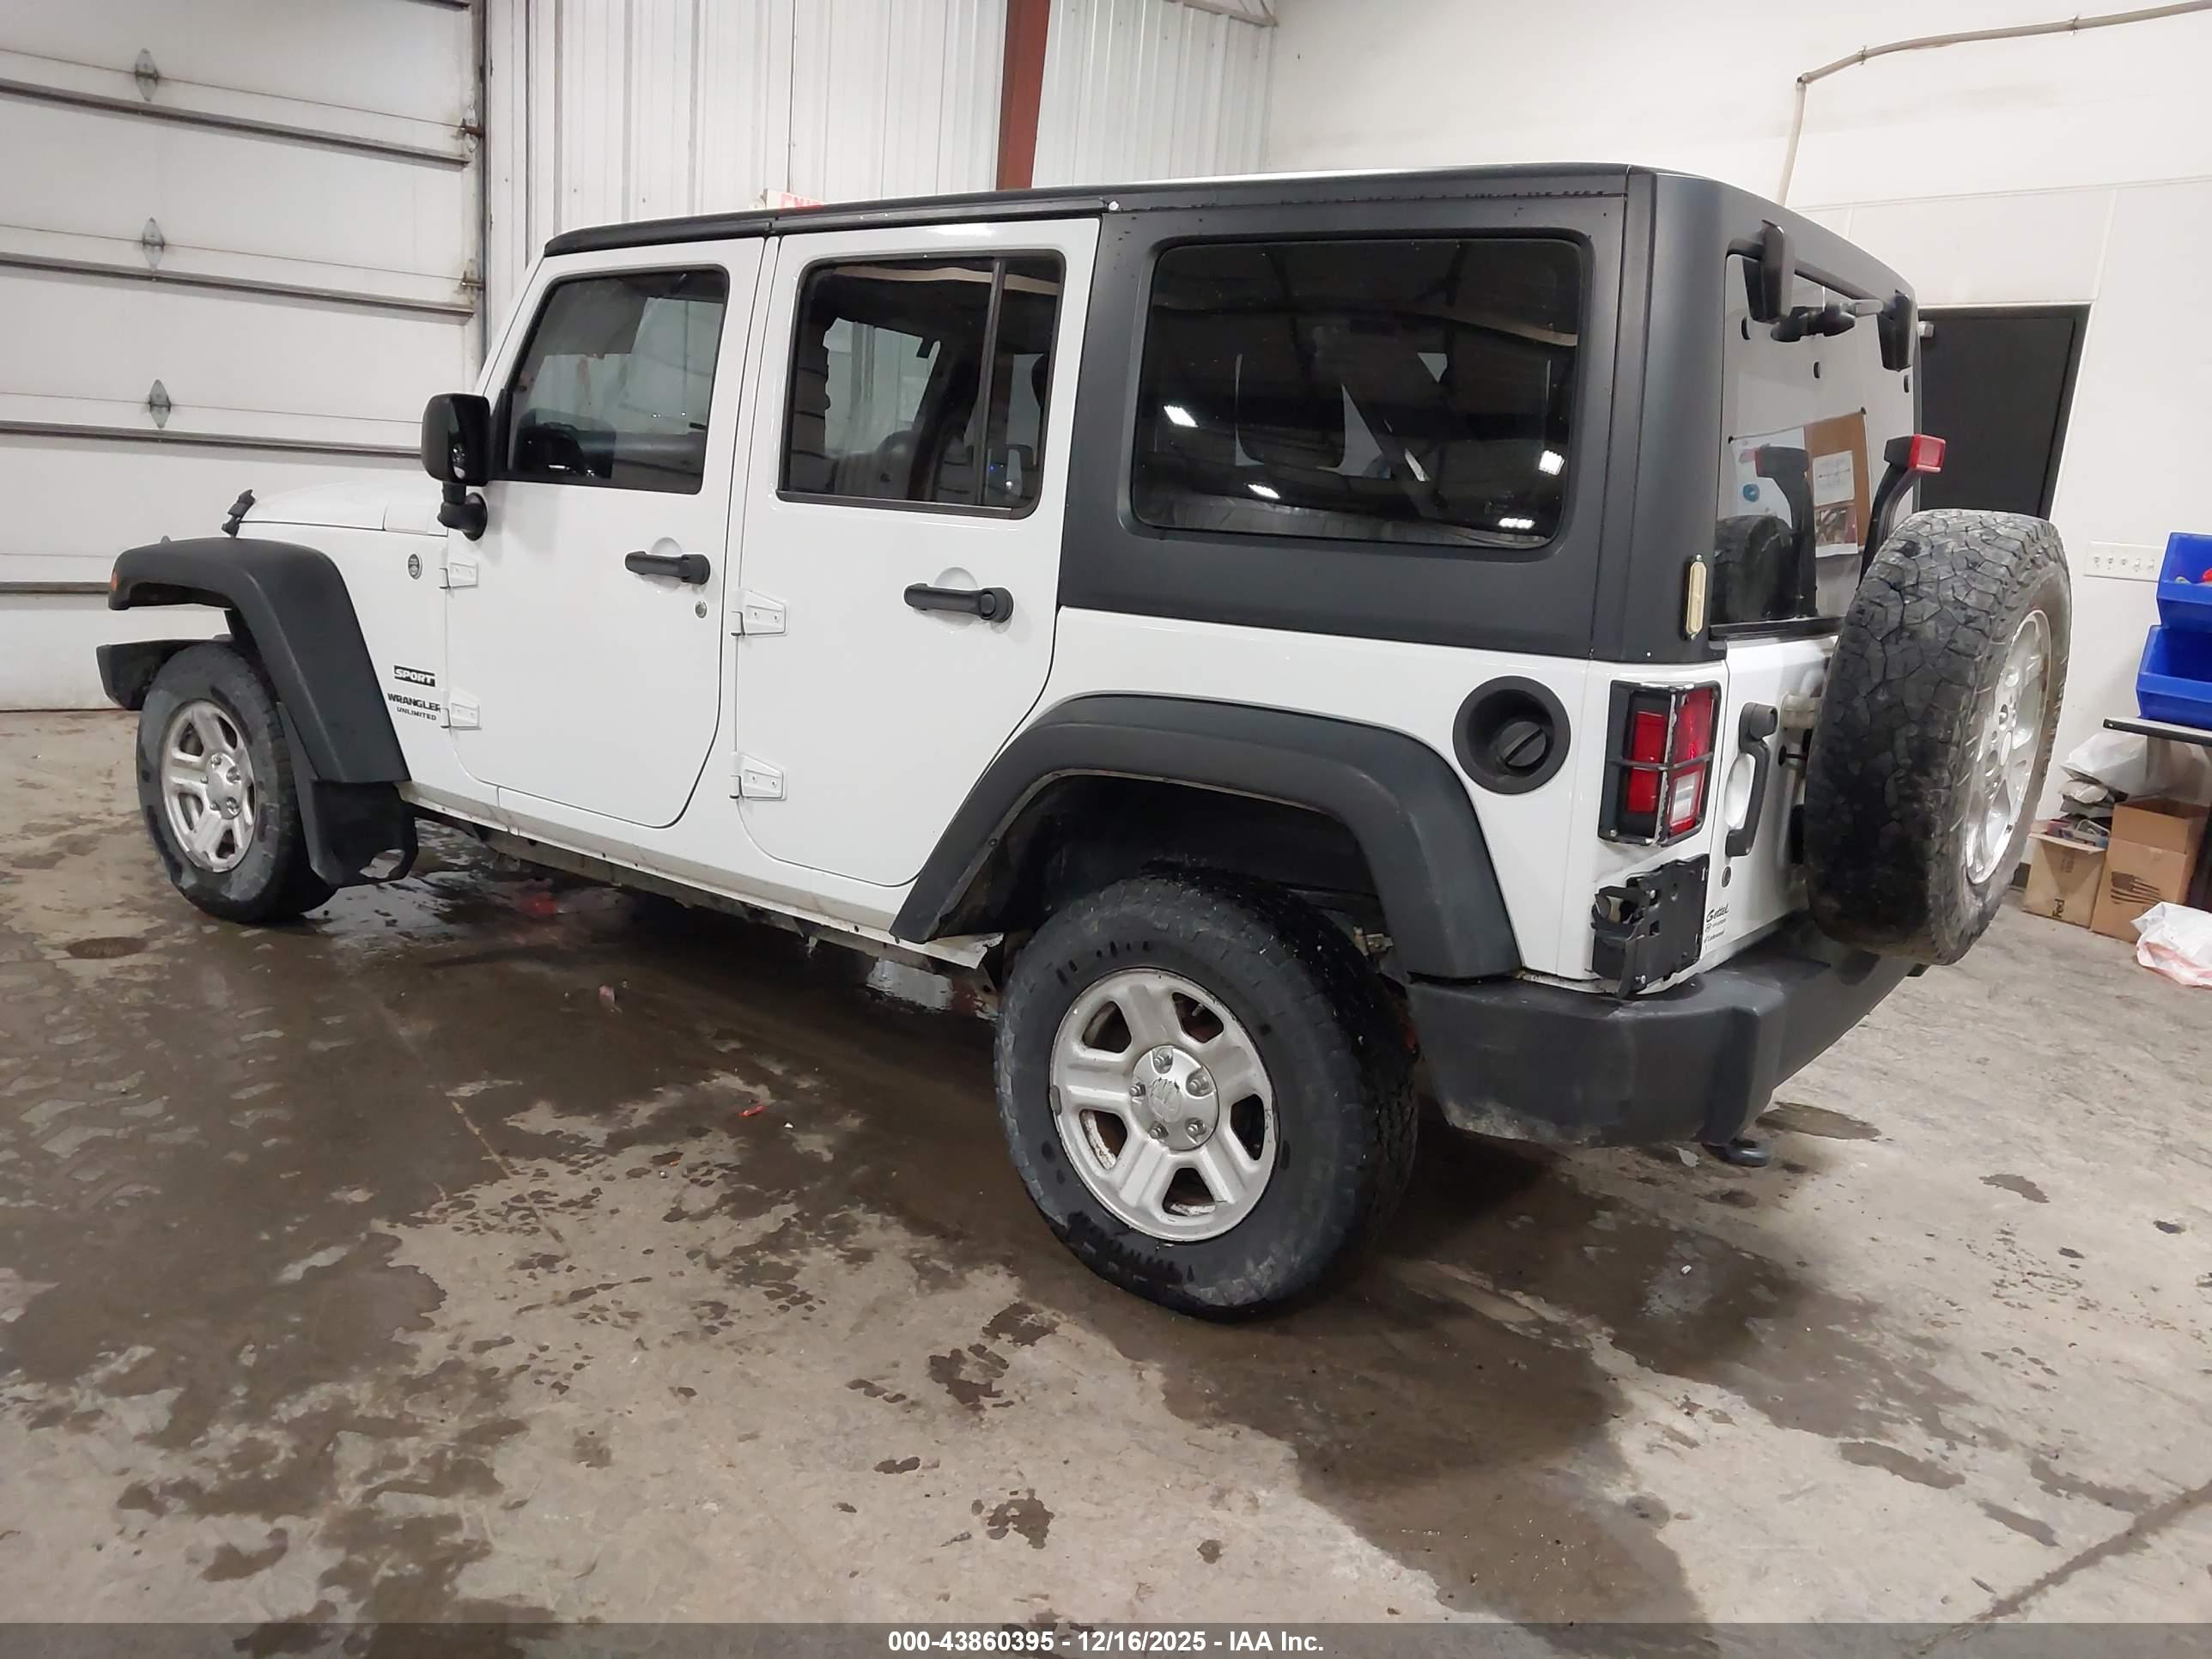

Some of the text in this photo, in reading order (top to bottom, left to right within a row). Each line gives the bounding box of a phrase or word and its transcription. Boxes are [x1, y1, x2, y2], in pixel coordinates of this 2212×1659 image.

[395, 667, 434, 685] SPORT
[387, 693, 441, 713] WRANGLER
[397, 707, 437, 721] UNLIMITED
